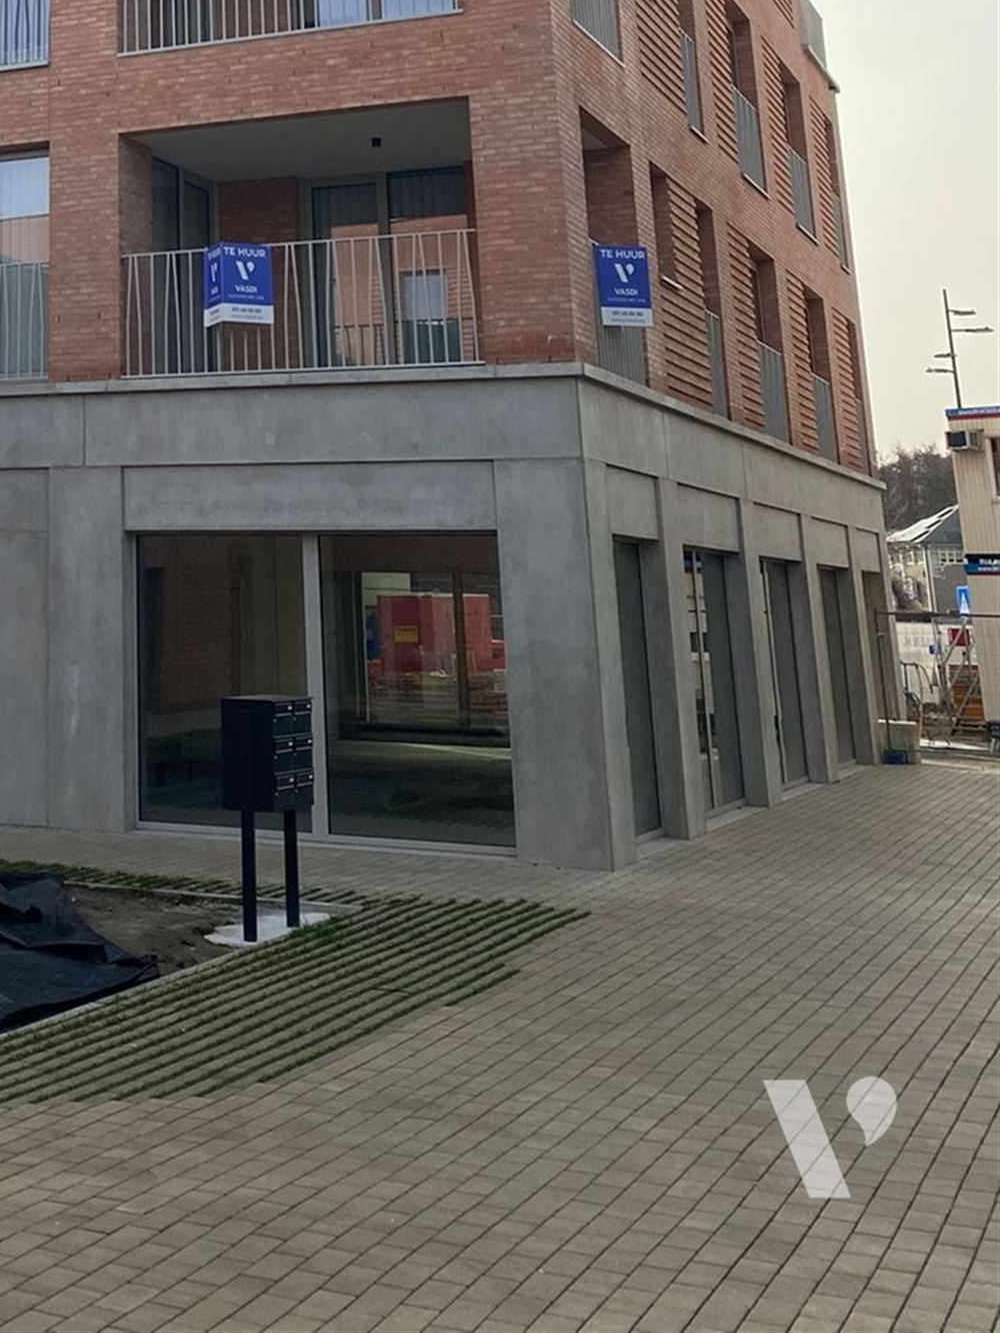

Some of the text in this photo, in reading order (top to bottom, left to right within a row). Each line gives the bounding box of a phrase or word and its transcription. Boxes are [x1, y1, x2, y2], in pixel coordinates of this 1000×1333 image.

[224, 246, 236, 256] TE
[237, 247, 266, 258] HUUR
[600, 249, 646, 260] TE HUUR
